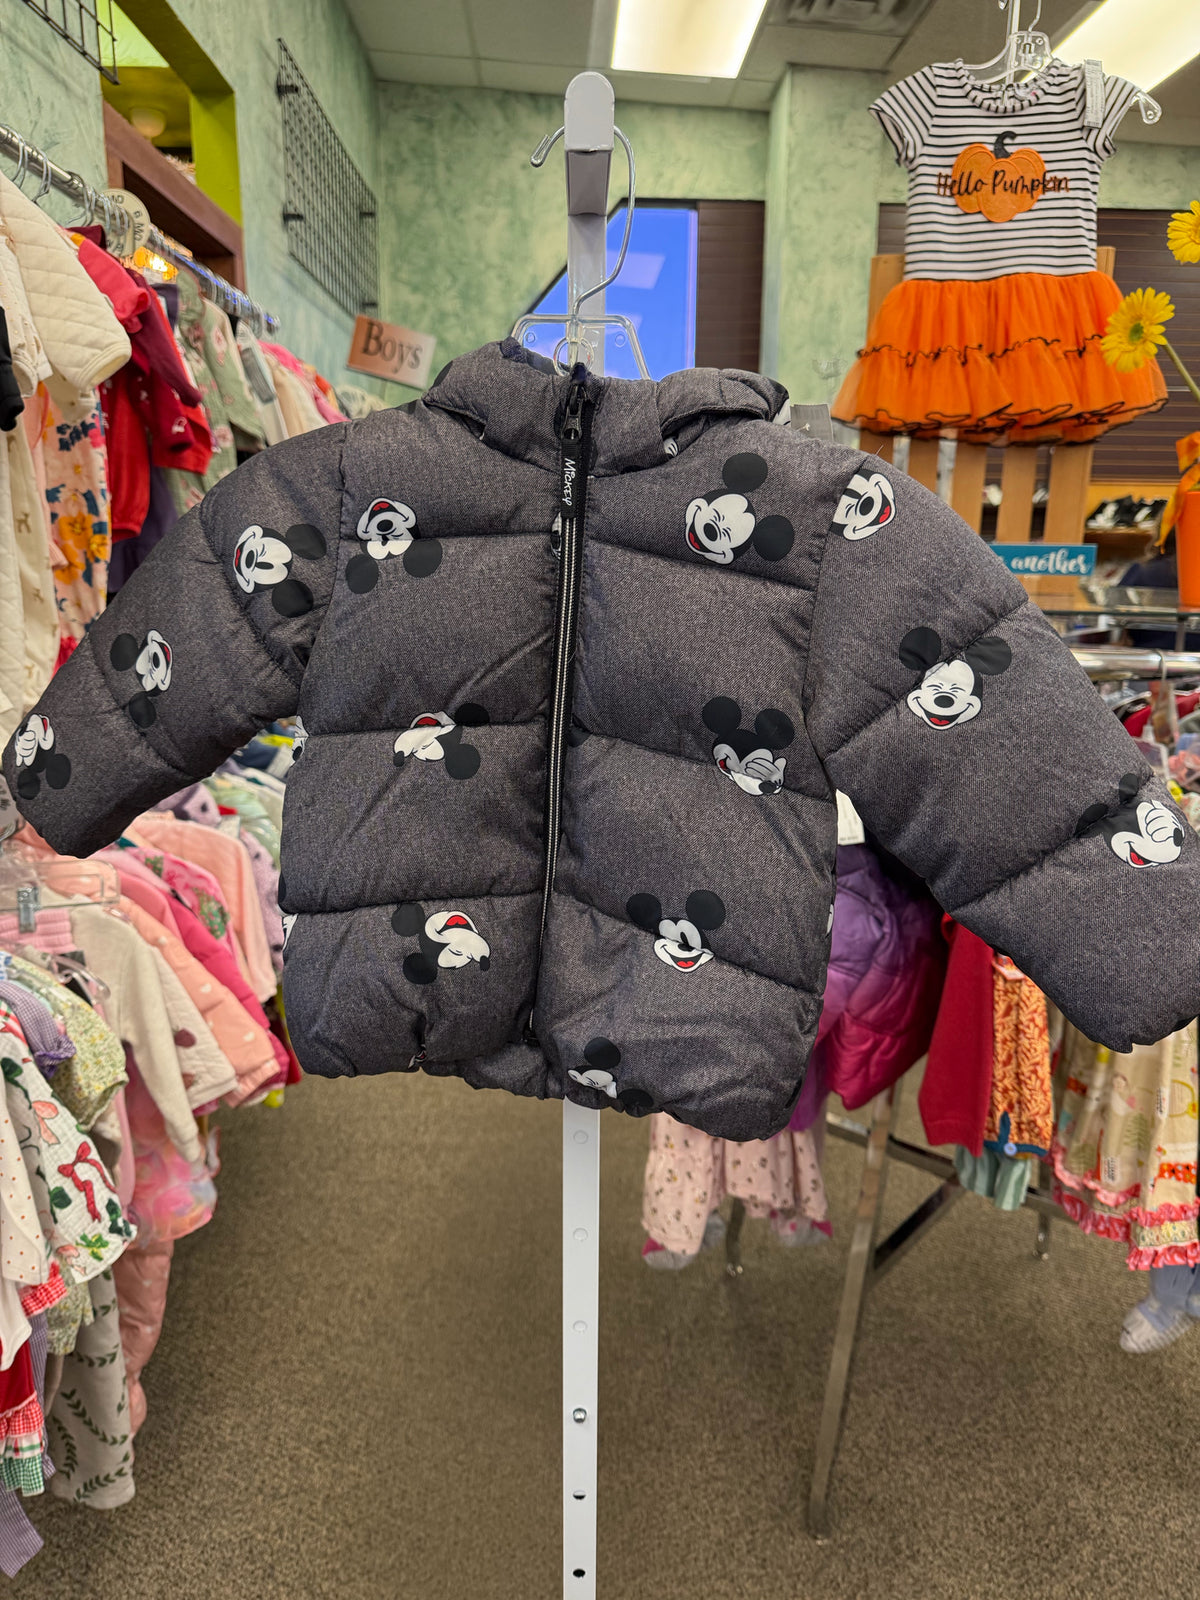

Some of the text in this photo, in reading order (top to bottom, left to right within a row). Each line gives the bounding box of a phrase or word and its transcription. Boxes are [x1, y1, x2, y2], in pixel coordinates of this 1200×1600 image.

[936, 168, 1070, 200] Hello Pumpkin
[362, 320, 423, 374] Boys
[1011, 548, 1091, 574] another
